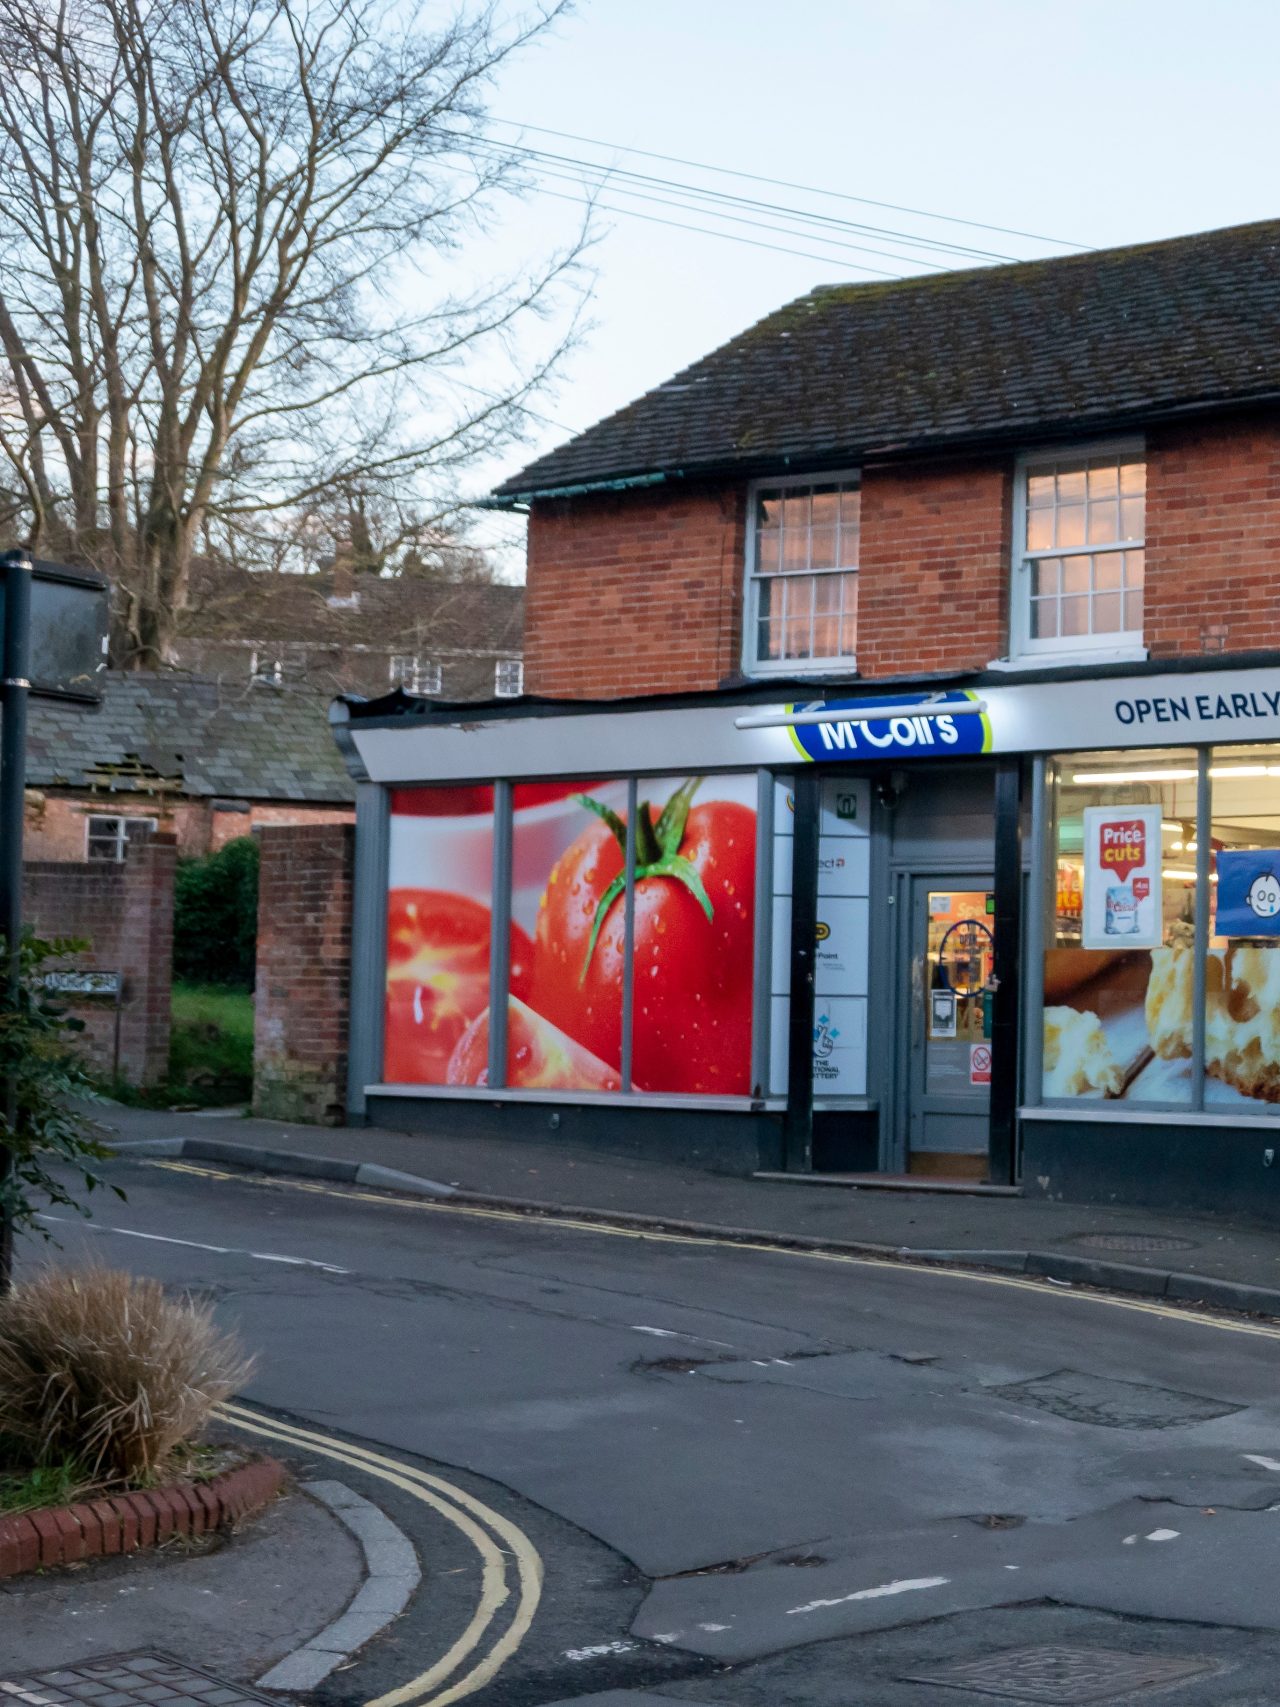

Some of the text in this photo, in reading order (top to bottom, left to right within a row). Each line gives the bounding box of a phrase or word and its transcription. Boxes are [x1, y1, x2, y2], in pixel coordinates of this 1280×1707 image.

[1115, 696, 1191, 725] OPEN
[1196, 691, 1280, 720] EARLY
[1104, 825, 1143, 844] Price
[1104, 844, 1141, 862] cuts
